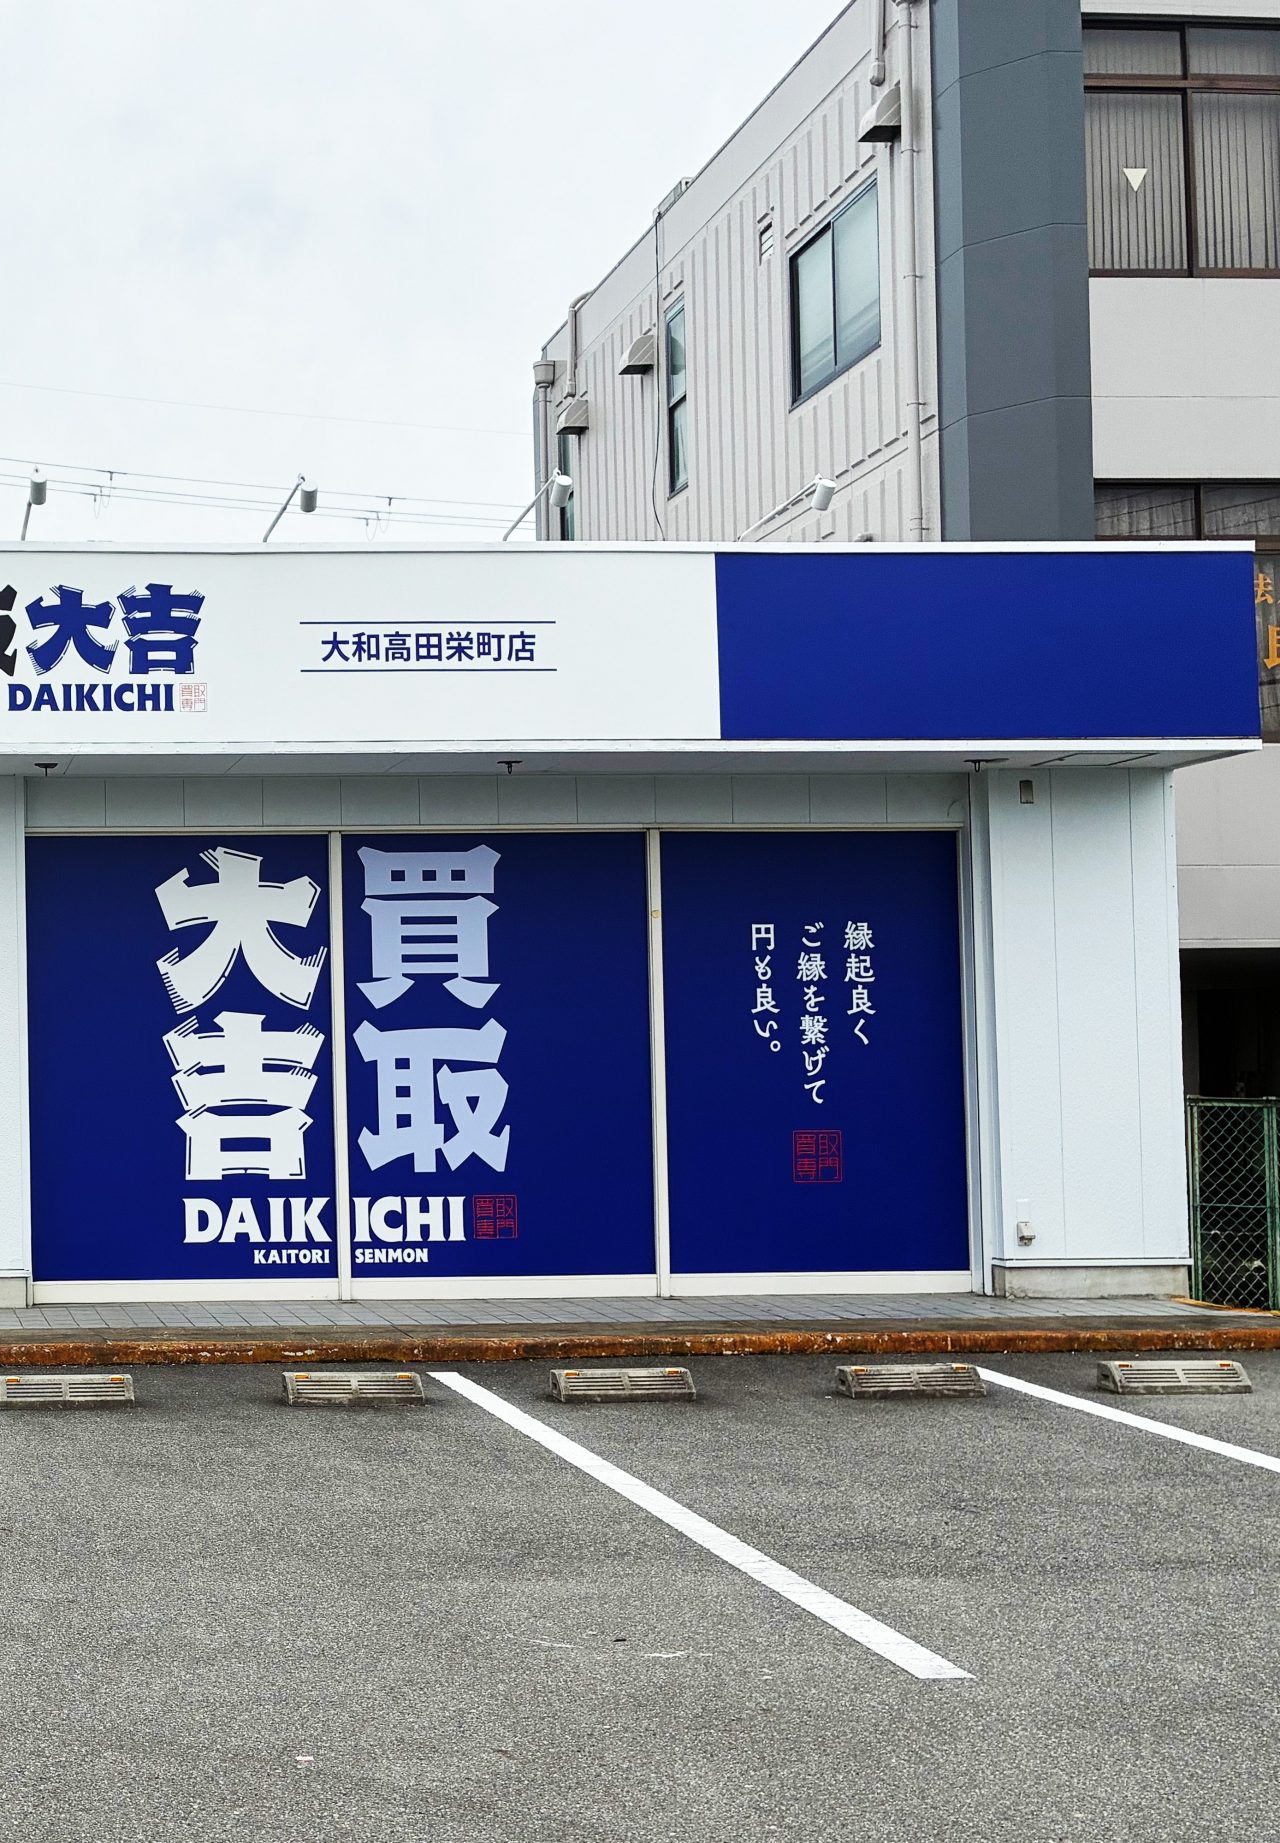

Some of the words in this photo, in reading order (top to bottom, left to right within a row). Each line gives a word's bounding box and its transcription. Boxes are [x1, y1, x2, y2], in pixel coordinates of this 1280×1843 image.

[8, 683, 174, 712] DAIKICHI
[321, 631, 536, 662] 大和高田栄町店
[155, 846, 328, 1180] 大吉
[353, 845, 510, 1173] 買取
[751, 923, 781, 1052] 円も良い。
[796, 921, 830, 1104] ご縁を繋げて
[844, 921, 876, 1045] 縁起良く
[182, 1196, 466, 1243] DAIKICHI
[254, 1249, 329, 1264] KAITORI
[355, 1248, 428, 1263] SENMON
